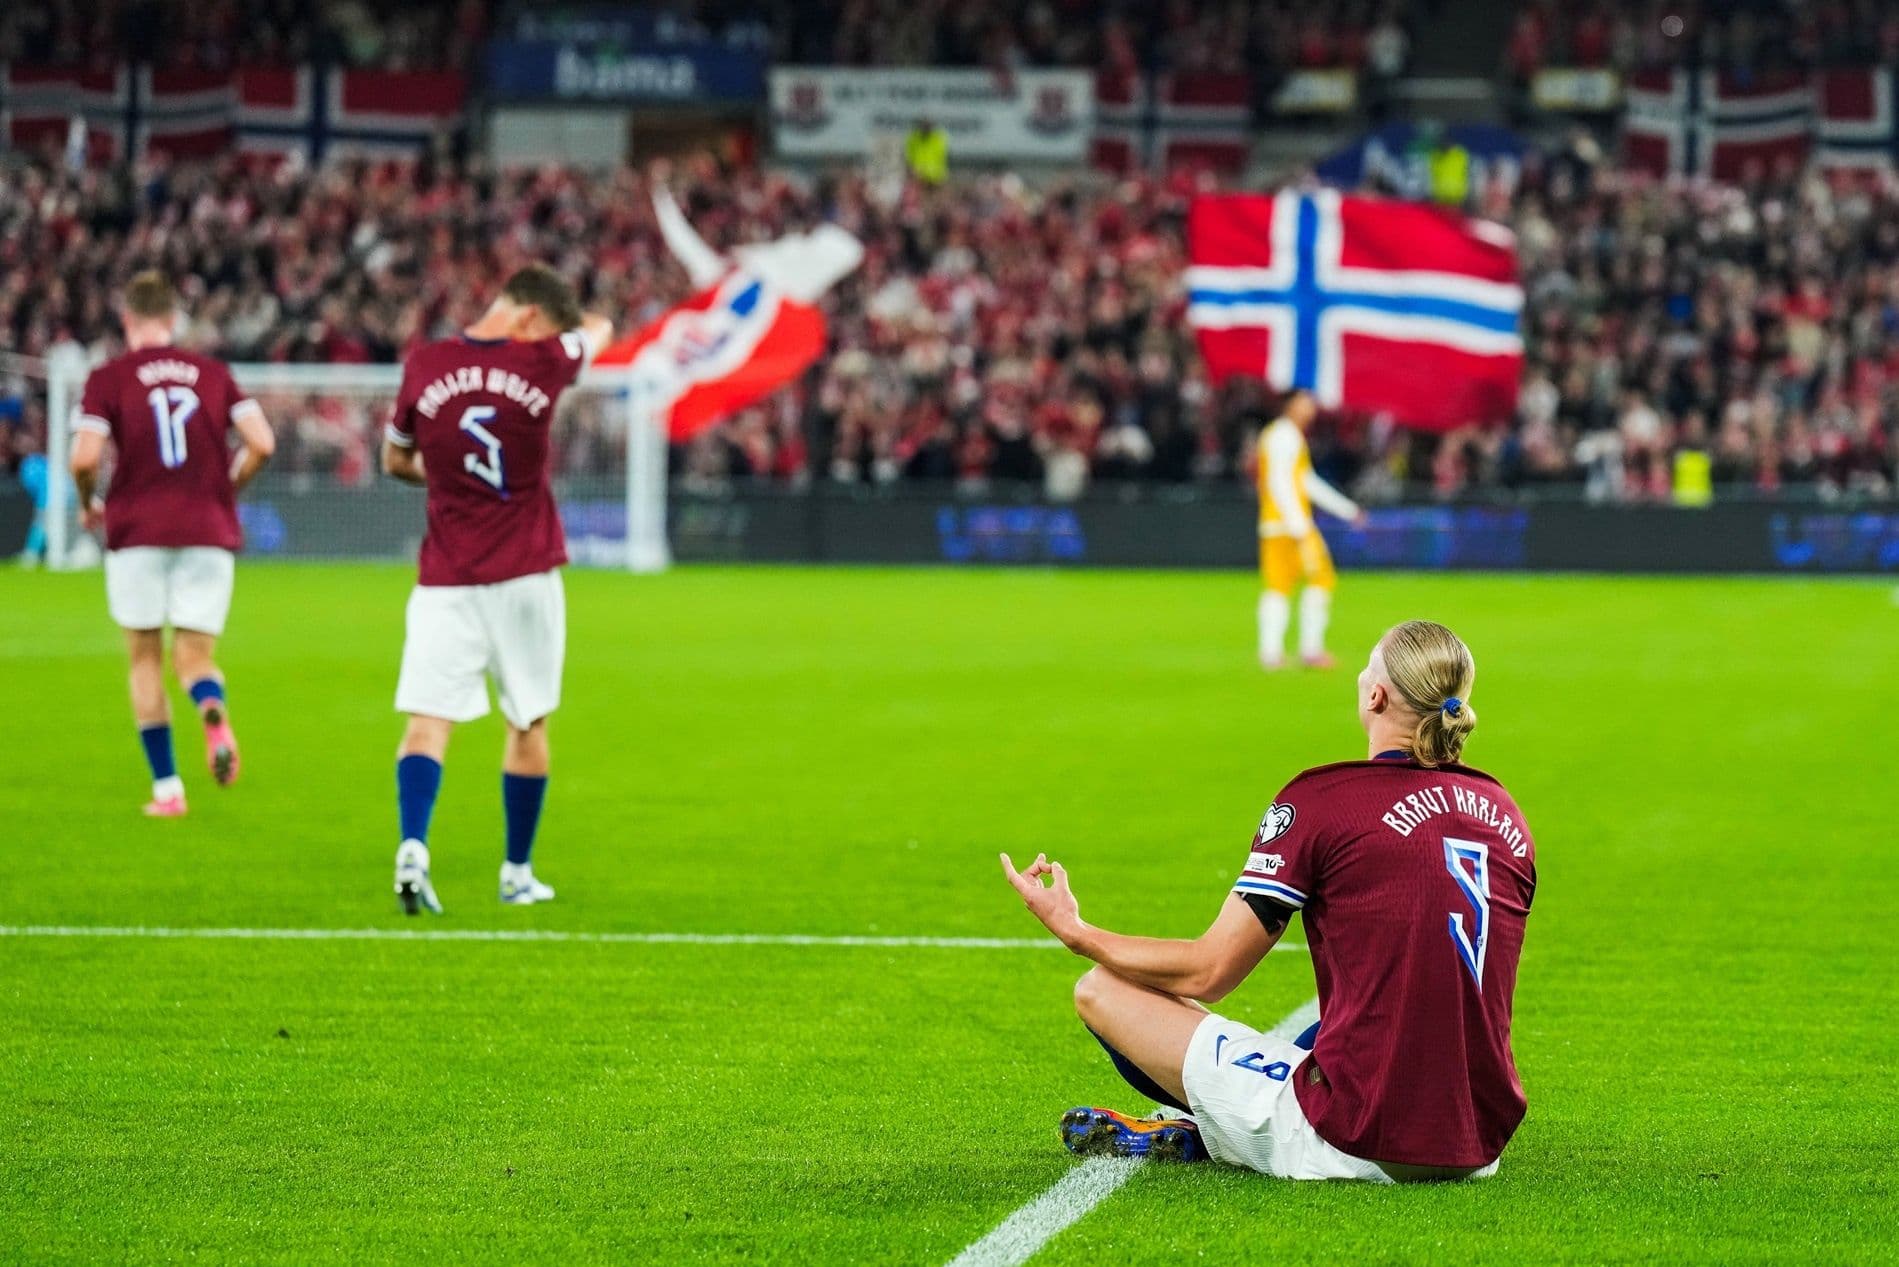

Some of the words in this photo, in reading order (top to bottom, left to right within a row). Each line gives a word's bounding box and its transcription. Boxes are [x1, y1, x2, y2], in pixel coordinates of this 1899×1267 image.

[147, 386, 201, 469] 17
[459, 405, 511, 501] 5
[1381, 785, 1450, 837] BRAUT
[1452, 785, 1528, 858] HAALAND
[1443, 837, 1490, 994] 9
